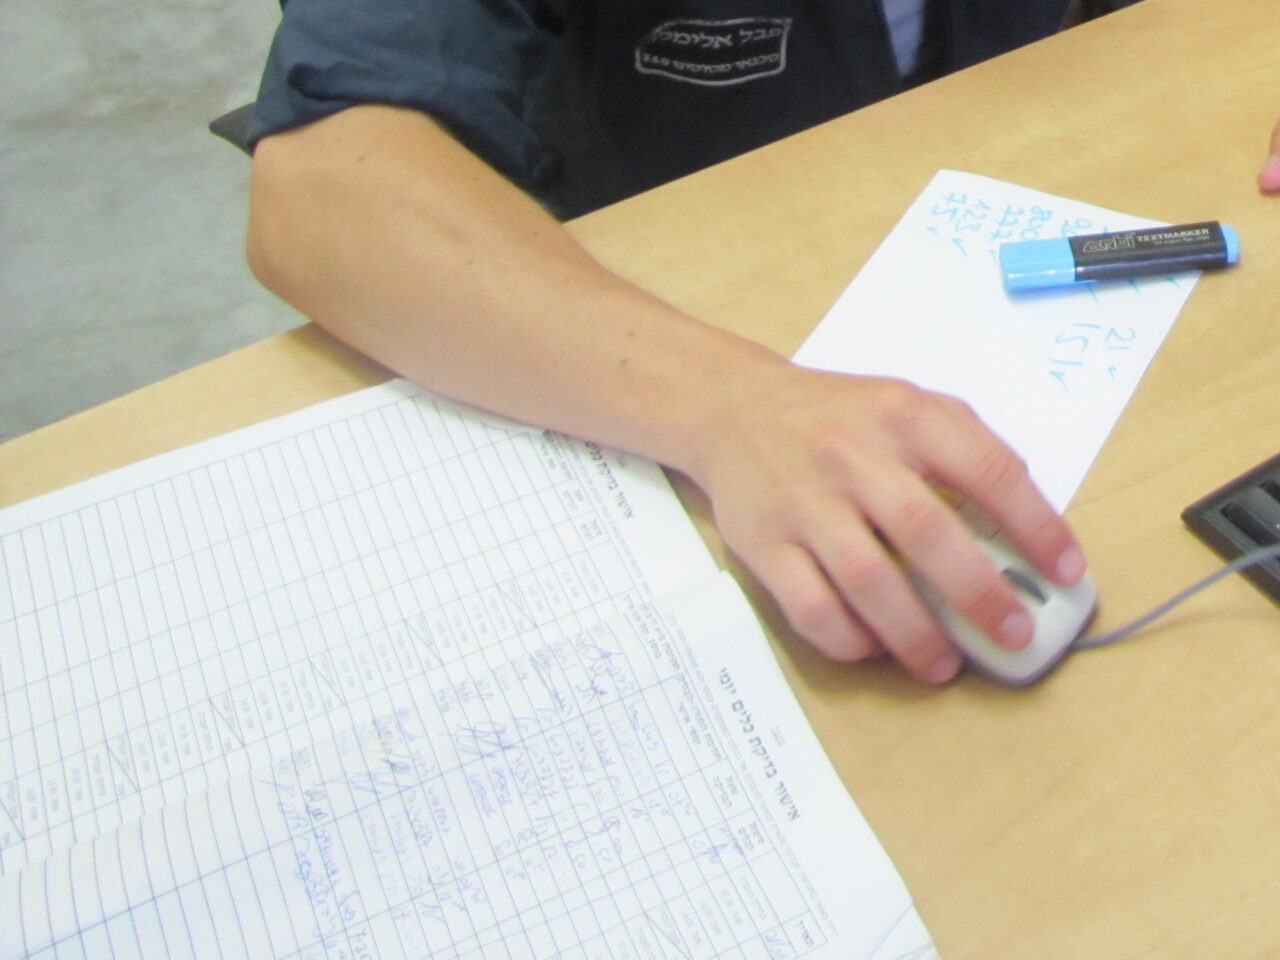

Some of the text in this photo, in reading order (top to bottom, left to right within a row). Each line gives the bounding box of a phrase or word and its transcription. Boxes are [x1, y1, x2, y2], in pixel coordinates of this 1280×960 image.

[1136, 228, 1210, 243] TEXTMARKER
[720, 667, 801, 821] אישור בדיקת כלים יומי
